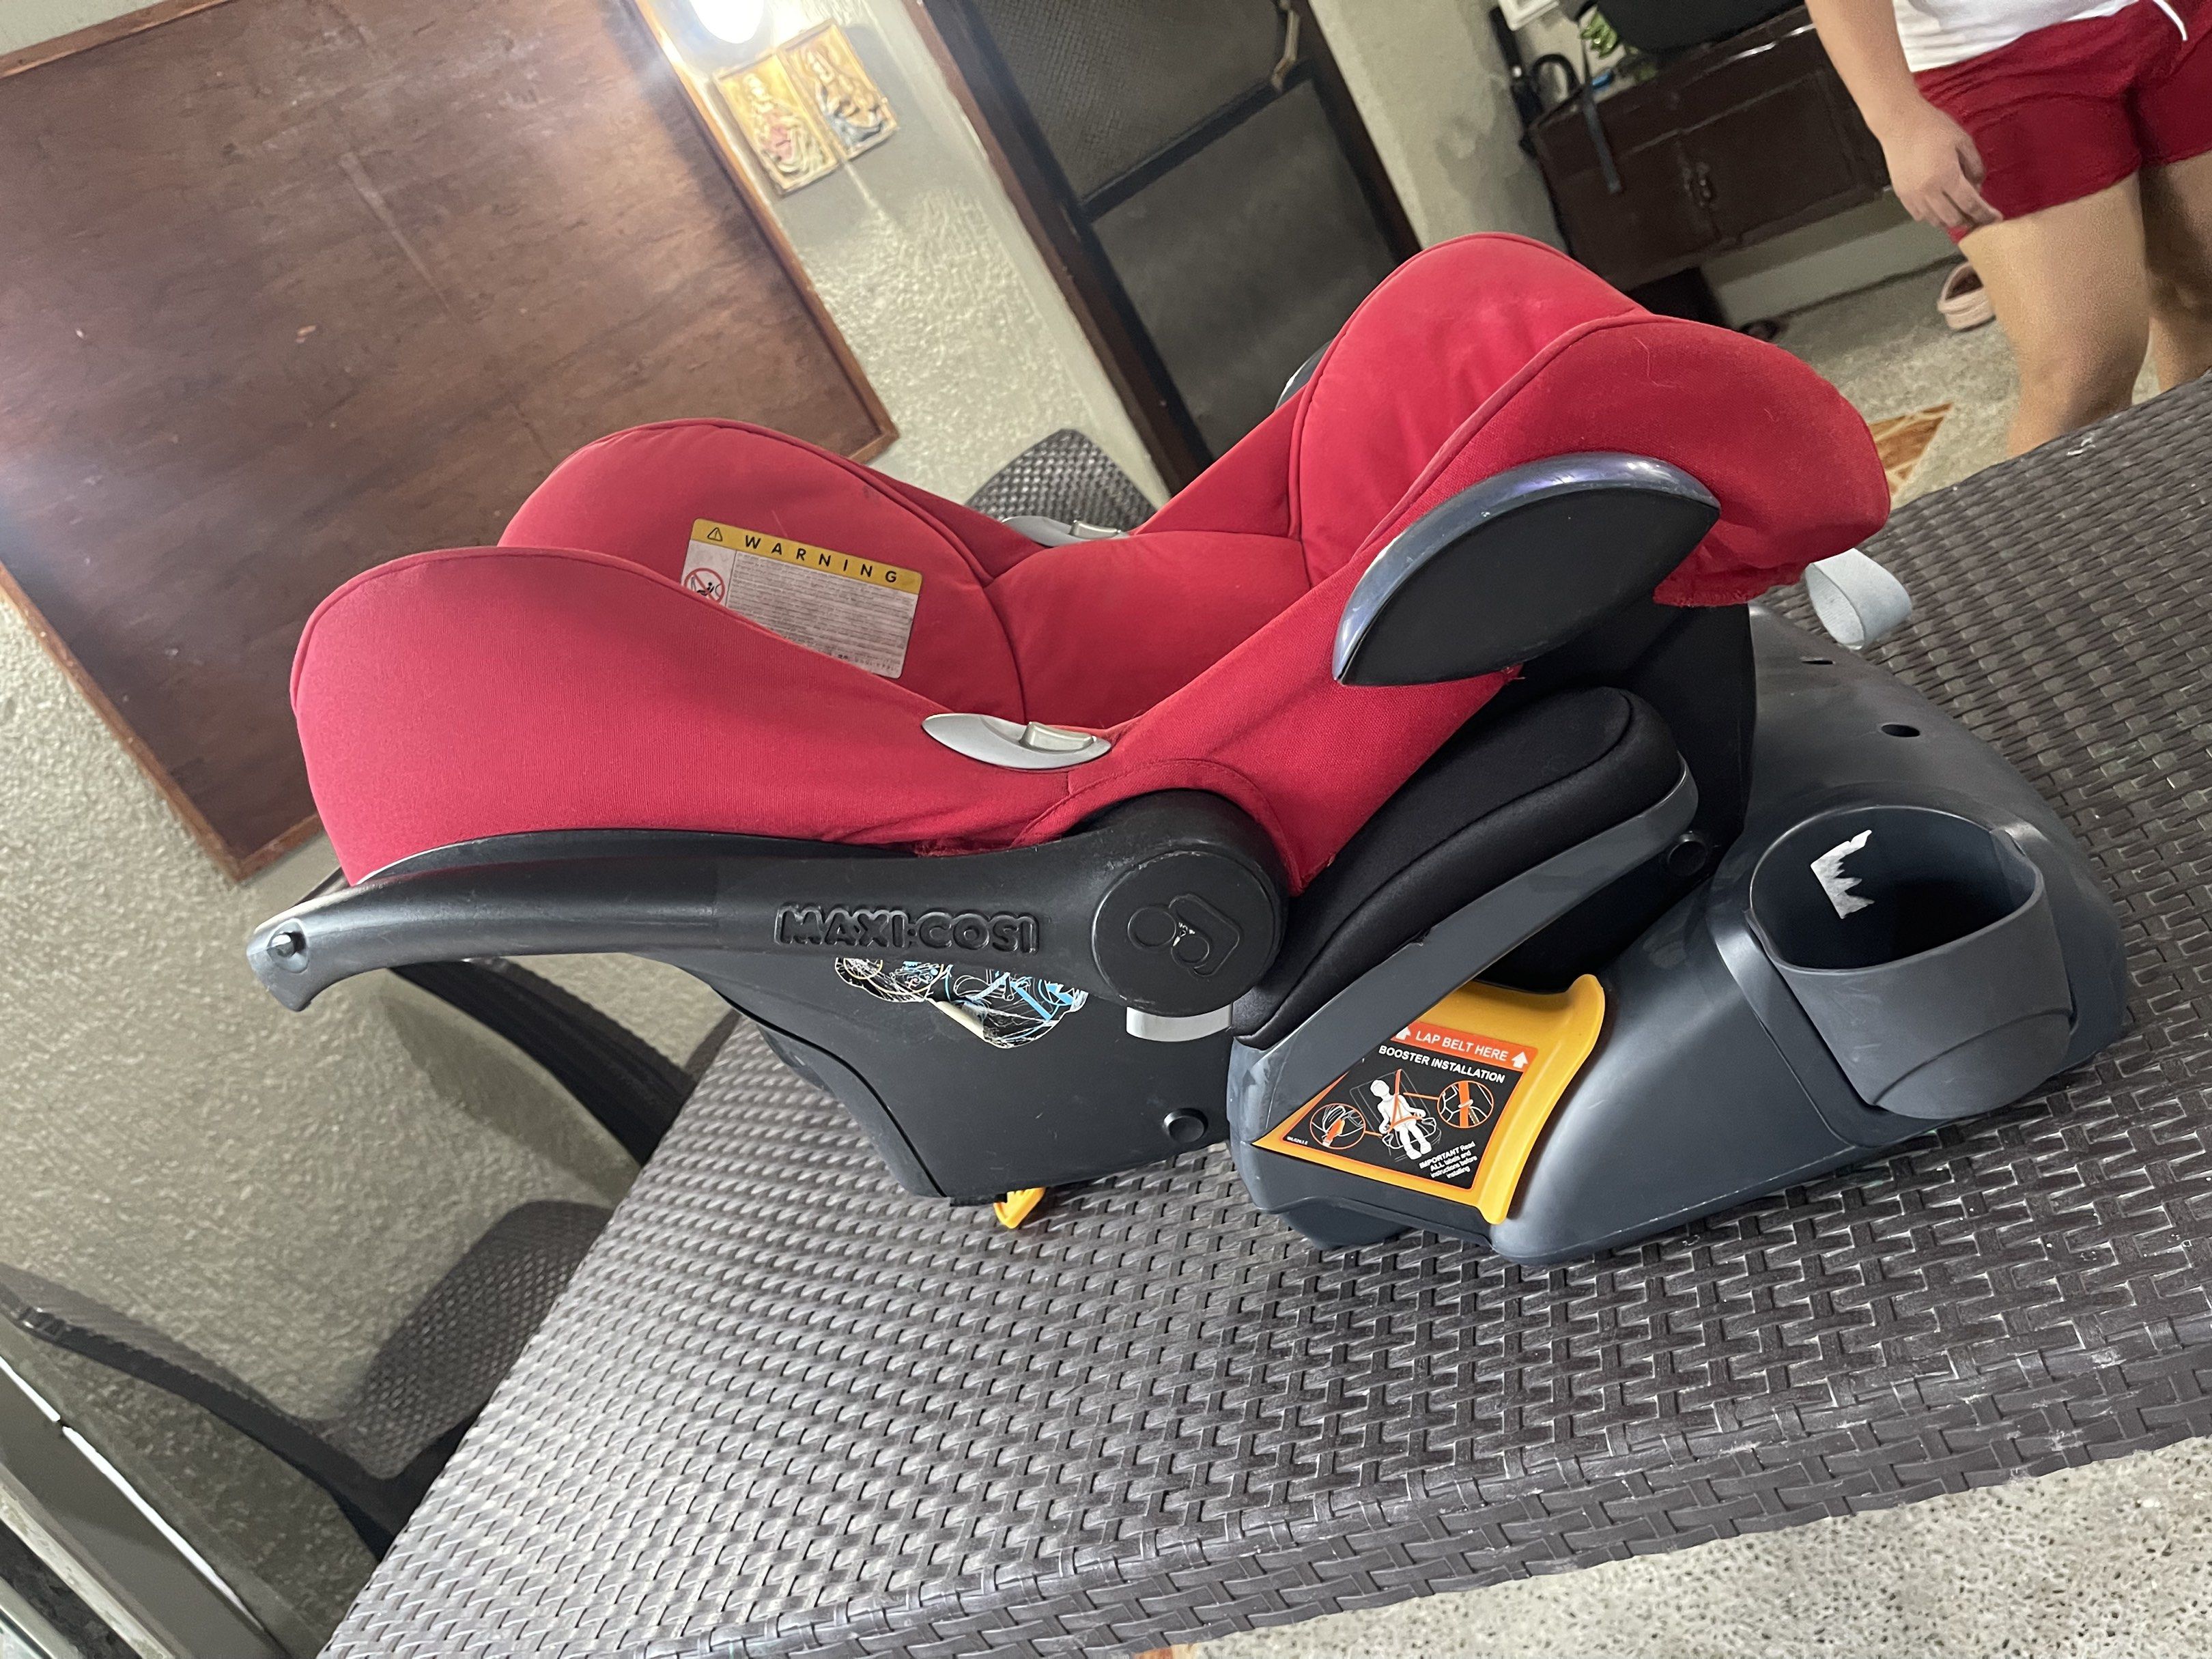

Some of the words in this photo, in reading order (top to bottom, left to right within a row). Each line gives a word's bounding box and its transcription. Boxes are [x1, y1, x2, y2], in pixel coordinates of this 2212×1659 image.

[745, 535, 897, 583] WARNING
[1415, 1030, 1441, 1044] LAP
[1442, 1037, 1474, 1052] BELT
[1474, 1045, 1509, 1062] HERE
[1378, 1045, 1432, 1066] BOOSTER
[1430, 1058, 1505, 1083] INSTALLATION
[1419, 1147, 1460, 1169] IMPORTANT
[1459, 1141, 1476, 1152] Read
[1430, 1162, 1445, 1172] ALL
